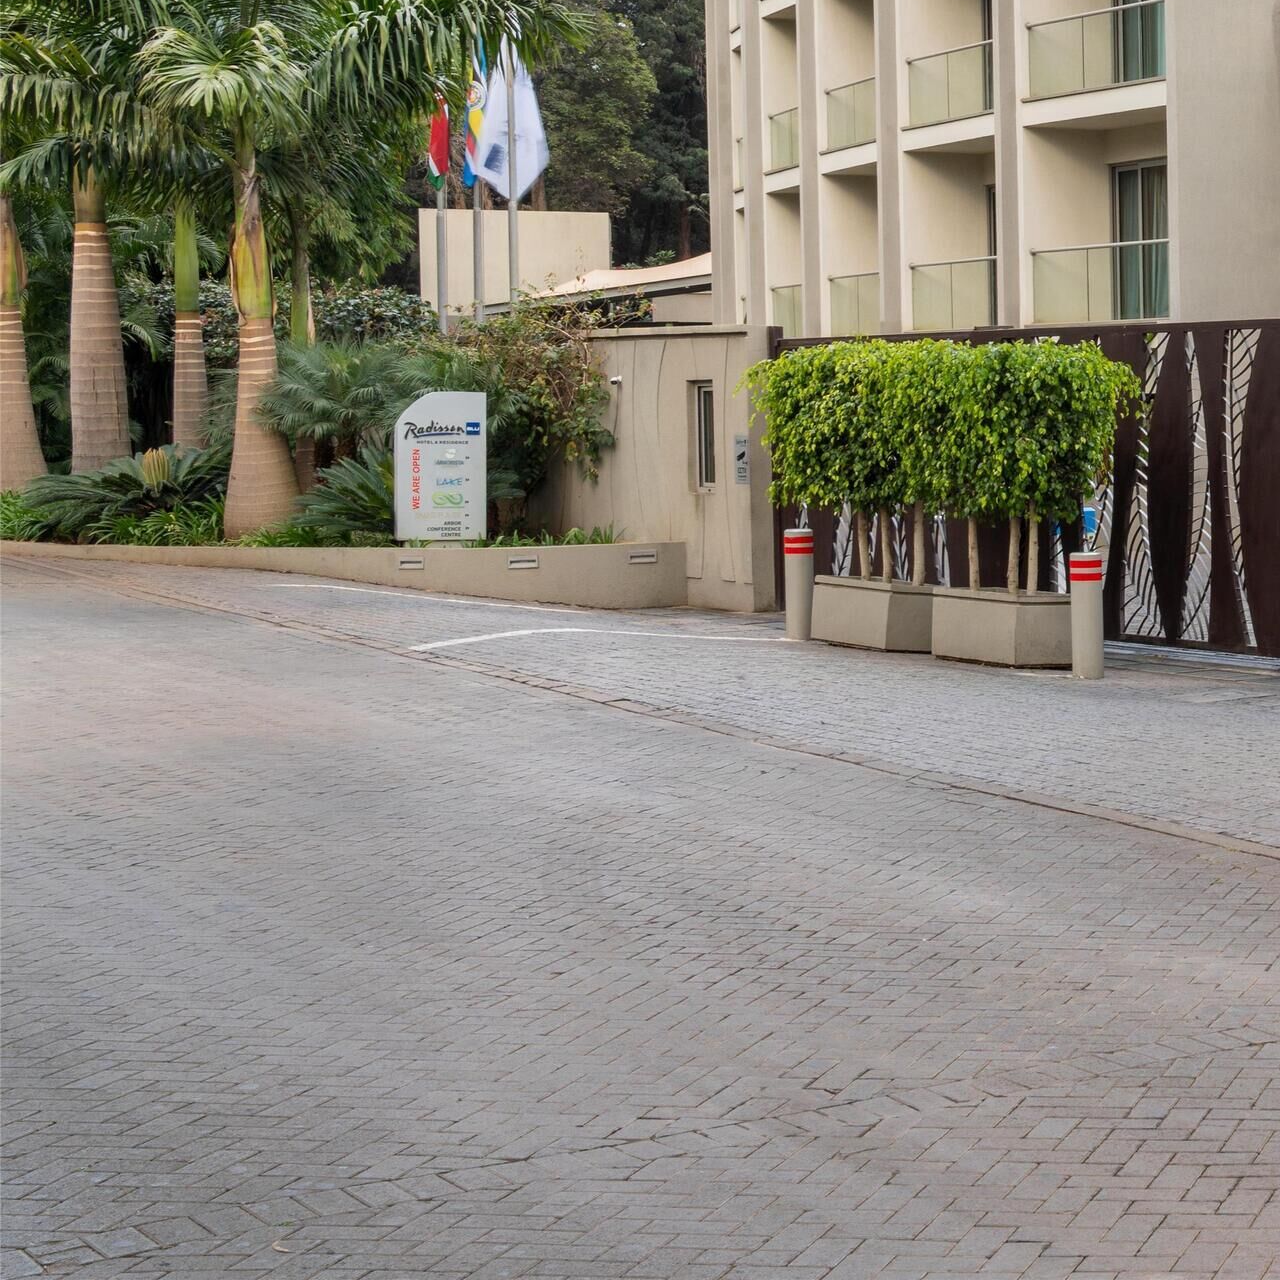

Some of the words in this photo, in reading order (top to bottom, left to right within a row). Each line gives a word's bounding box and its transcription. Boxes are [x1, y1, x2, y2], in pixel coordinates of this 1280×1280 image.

[404, 420, 465, 440] Radisson
[412, 449, 420, 473] OPEN
[412, 475, 420, 494] ARE
[412, 495, 420, 510] WE
